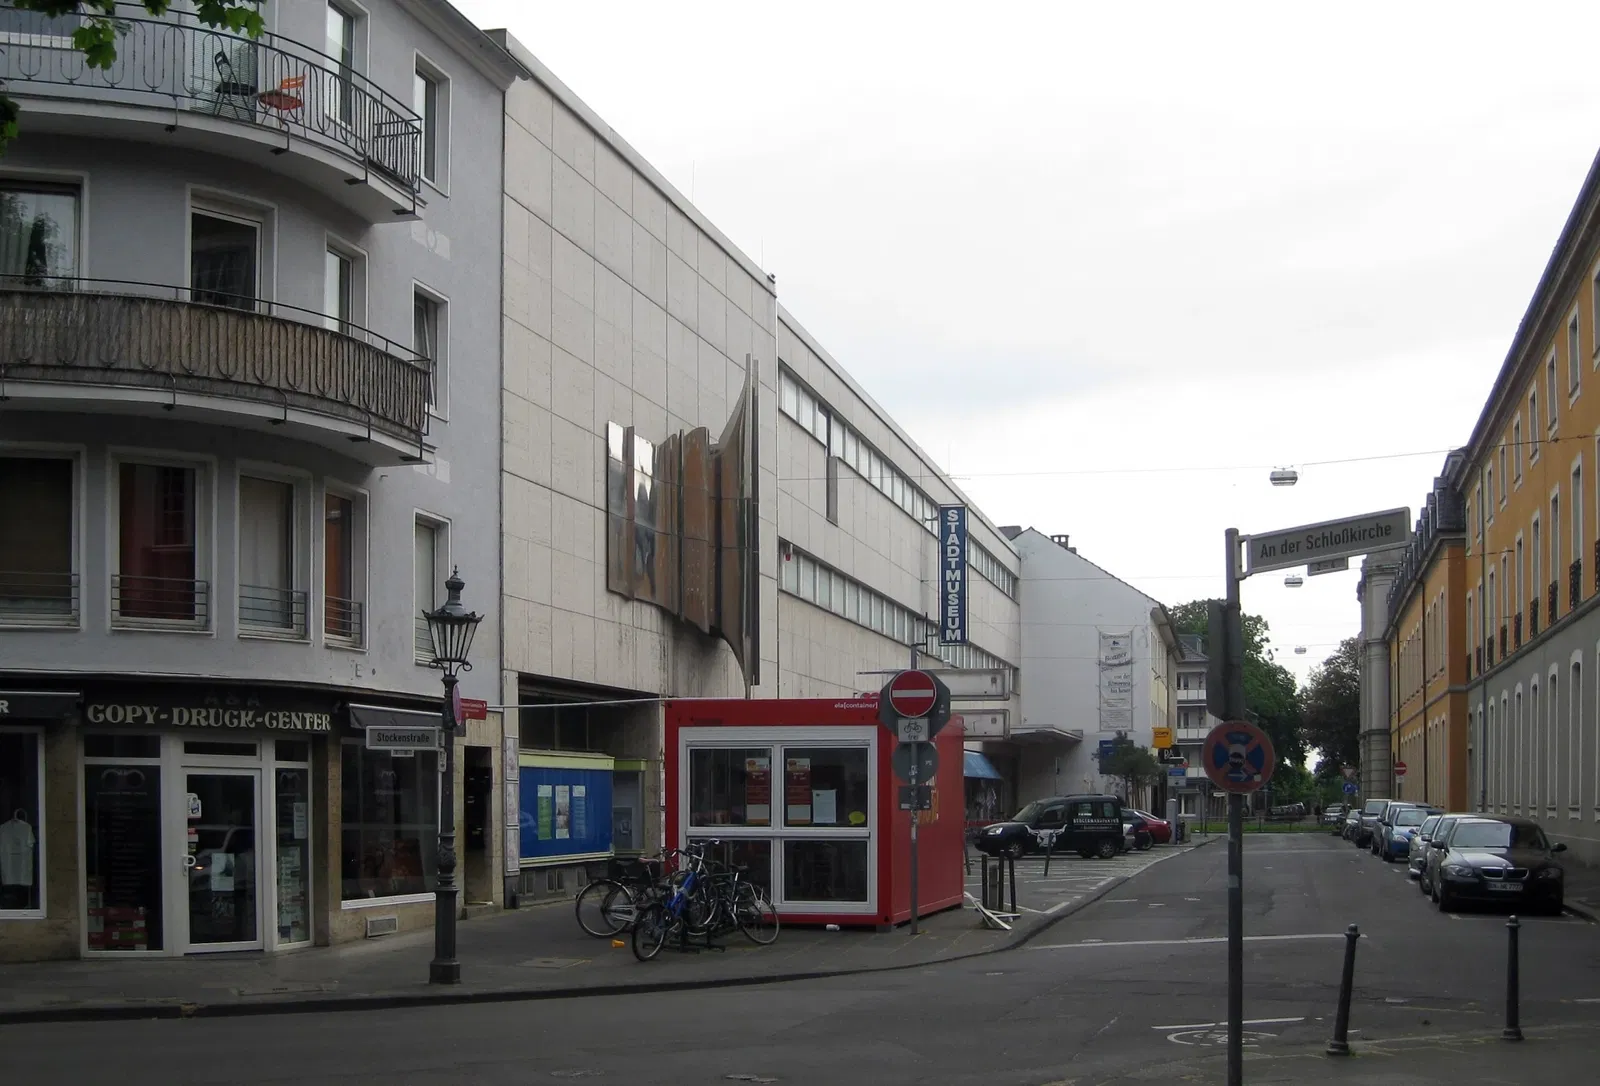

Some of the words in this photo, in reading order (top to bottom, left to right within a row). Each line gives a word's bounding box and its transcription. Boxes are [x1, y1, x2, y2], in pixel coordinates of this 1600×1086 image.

[1260, 544, 1275, 558] An
[1280, 539, 1302, 555] der
[1306, 523, 1392, 549] Schloßkirche
[946, 509, 961, 641] STADTMUSEUM
[377, 732, 430, 743] Stockenstraße
